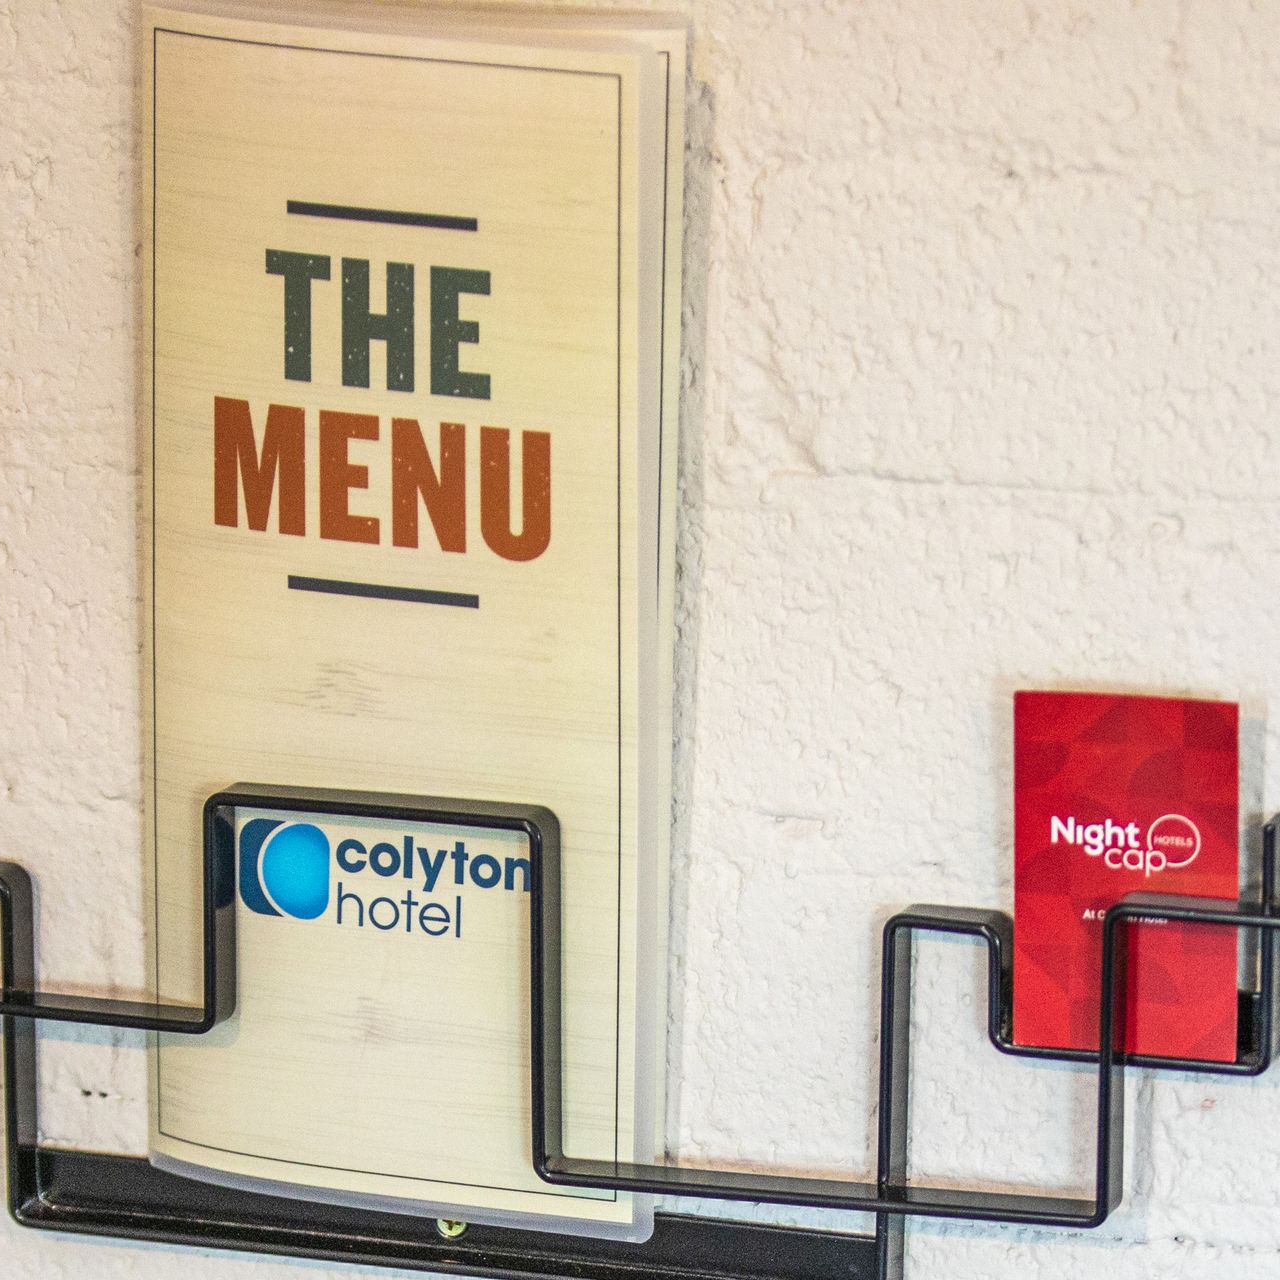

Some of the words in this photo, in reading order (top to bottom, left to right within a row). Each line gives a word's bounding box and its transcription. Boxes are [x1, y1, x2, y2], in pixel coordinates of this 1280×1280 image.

[265, 248, 491, 400] THE
[214, 396, 551, 562] MENU
[336, 836, 531, 892] colyton
[1050, 815, 1141, 857] Night
[1104, 848, 1167, 878] cap
[1153, 835, 1195, 848] HOTELS
[336, 882, 461, 938] hotel
